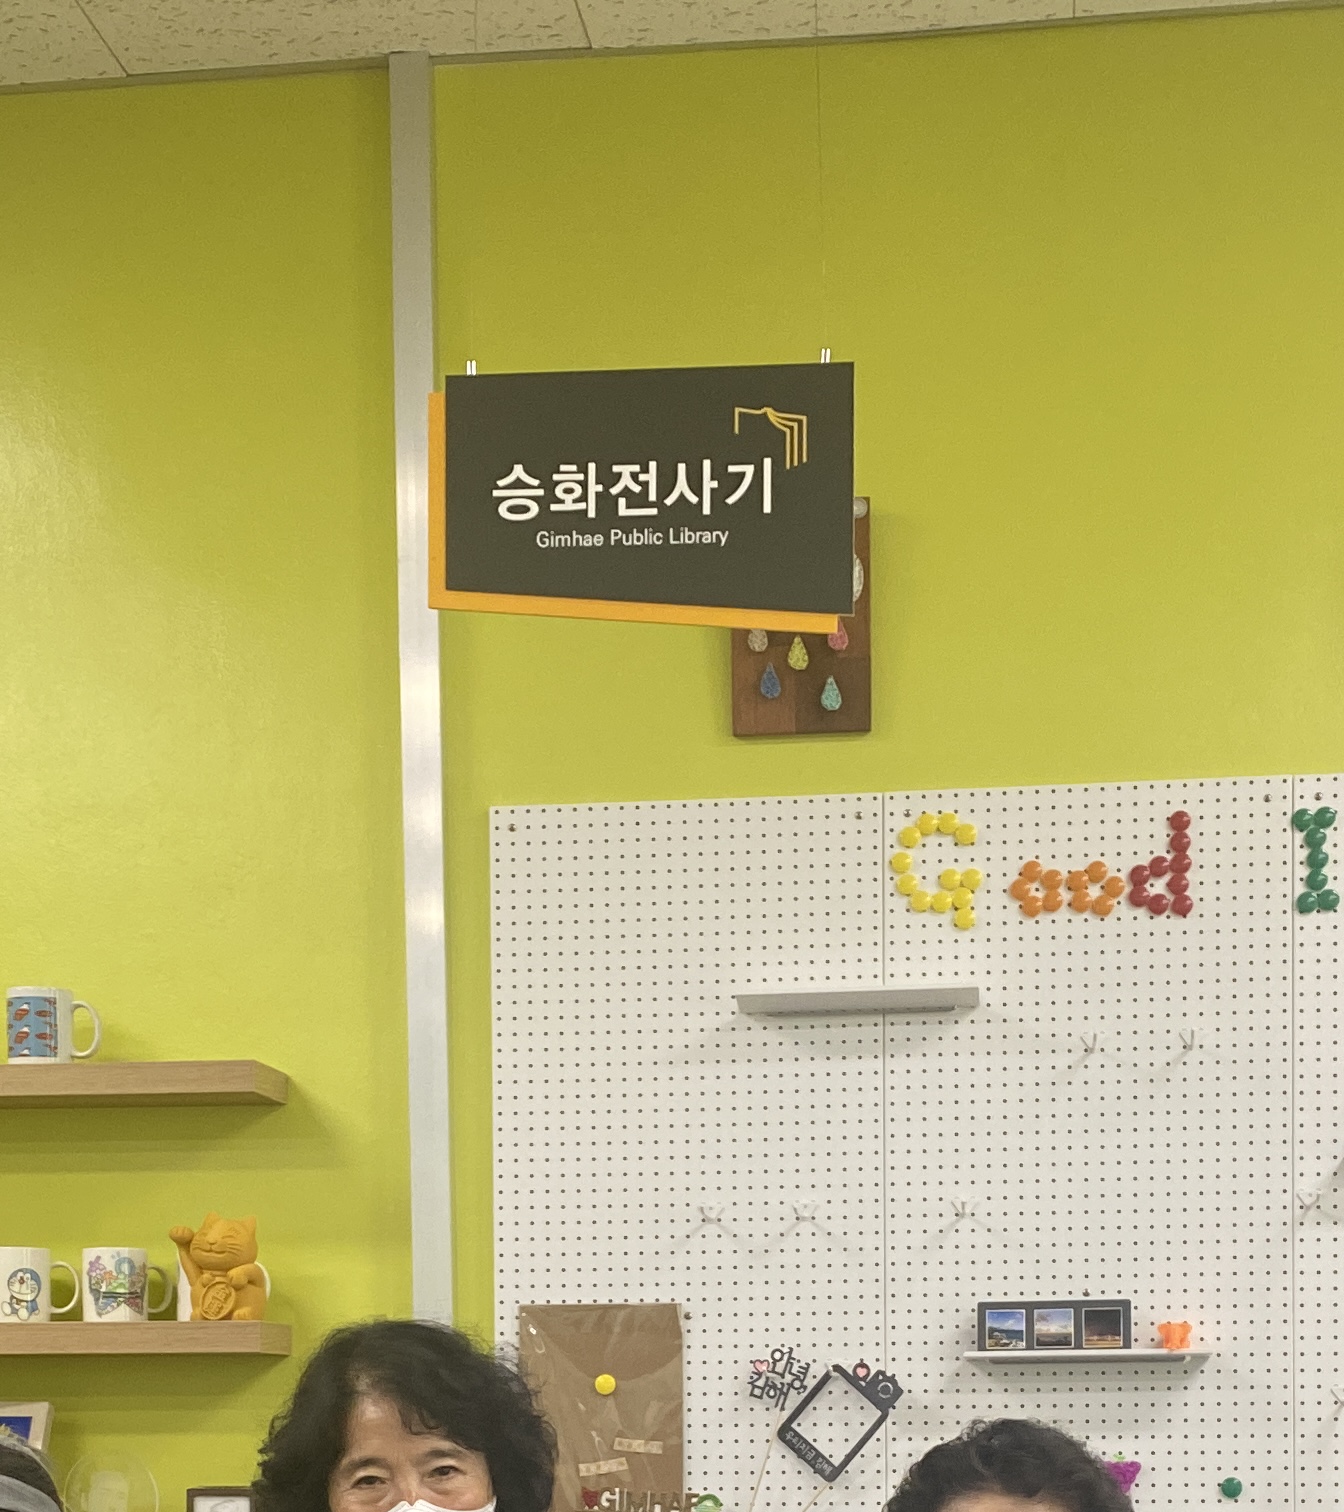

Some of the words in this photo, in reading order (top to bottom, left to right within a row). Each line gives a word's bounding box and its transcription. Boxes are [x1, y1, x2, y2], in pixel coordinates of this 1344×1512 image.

[491, 456, 773, 522] 승화전사기
[535, 530, 605, 549] Gimhae
[610, 527, 664, 546] Public
[669, 526, 729, 547] Library
[747, 1370, 791, 1412] 김해
